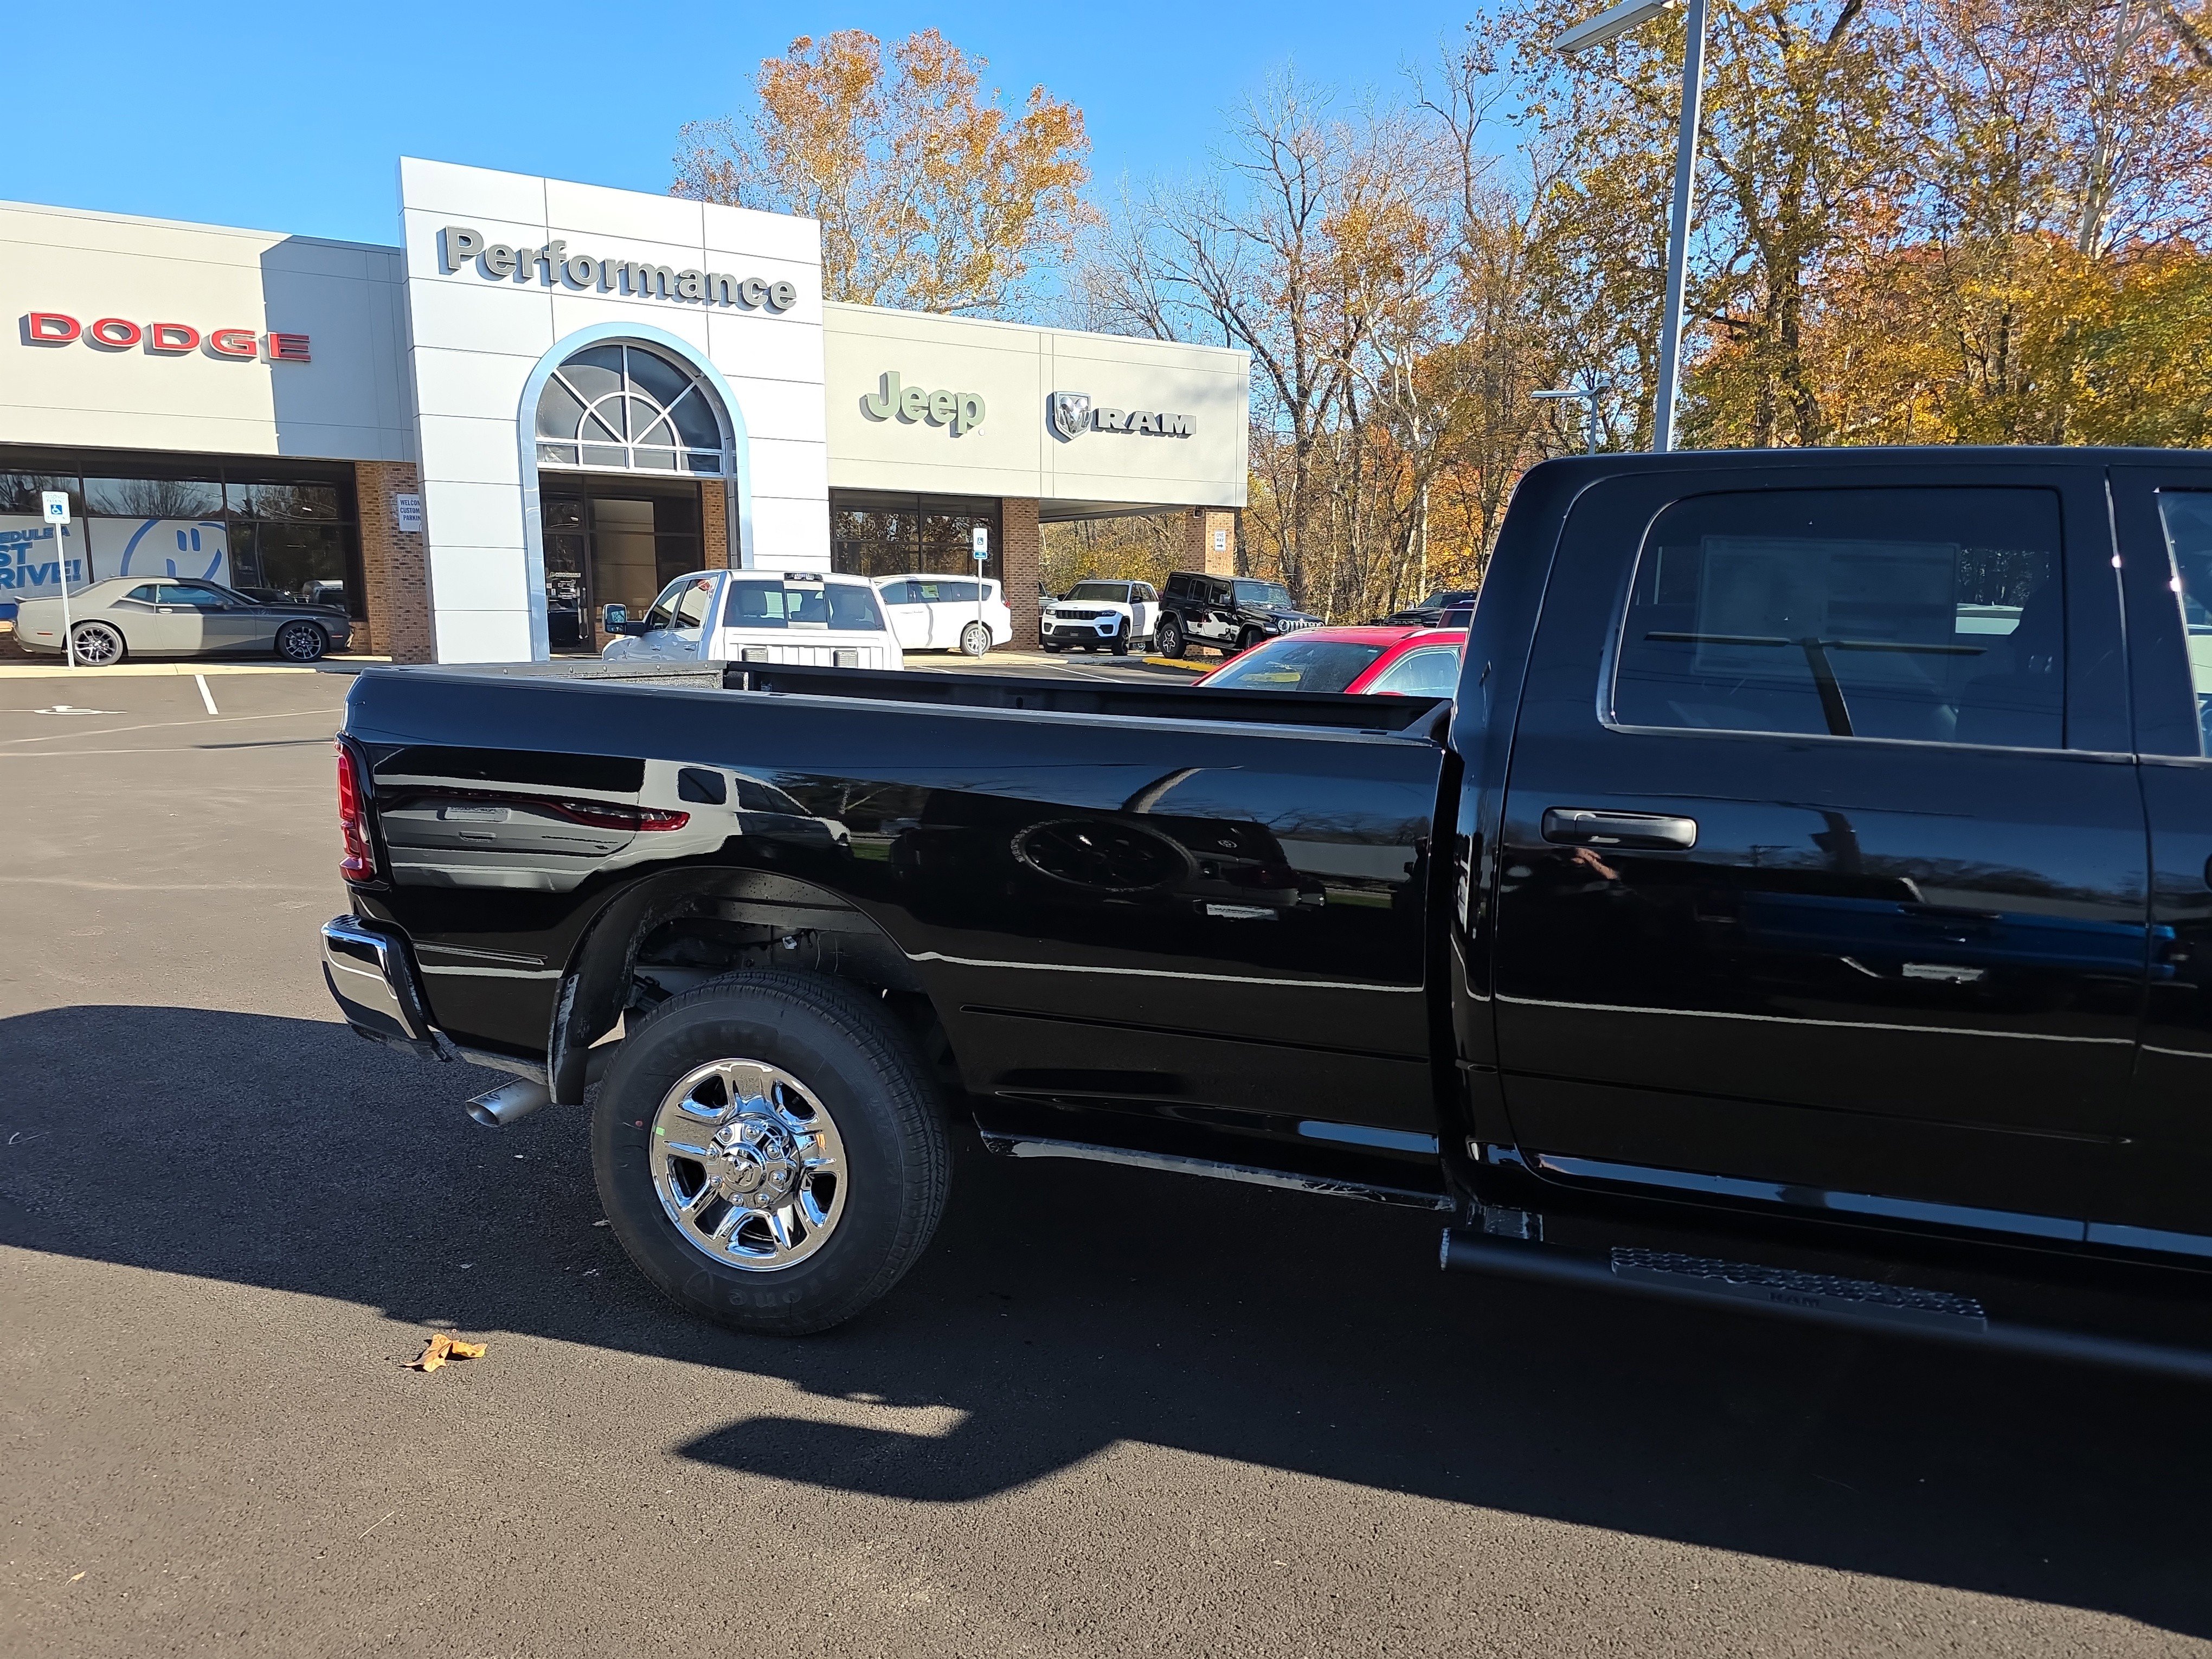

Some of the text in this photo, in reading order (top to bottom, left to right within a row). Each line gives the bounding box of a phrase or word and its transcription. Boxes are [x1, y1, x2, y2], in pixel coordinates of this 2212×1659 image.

[445, 225, 796, 308] Performance
[29, 311, 311, 362] DODGE
[866, 371, 985, 434] Jeep
[1097, 408, 1196, 434] RAM
